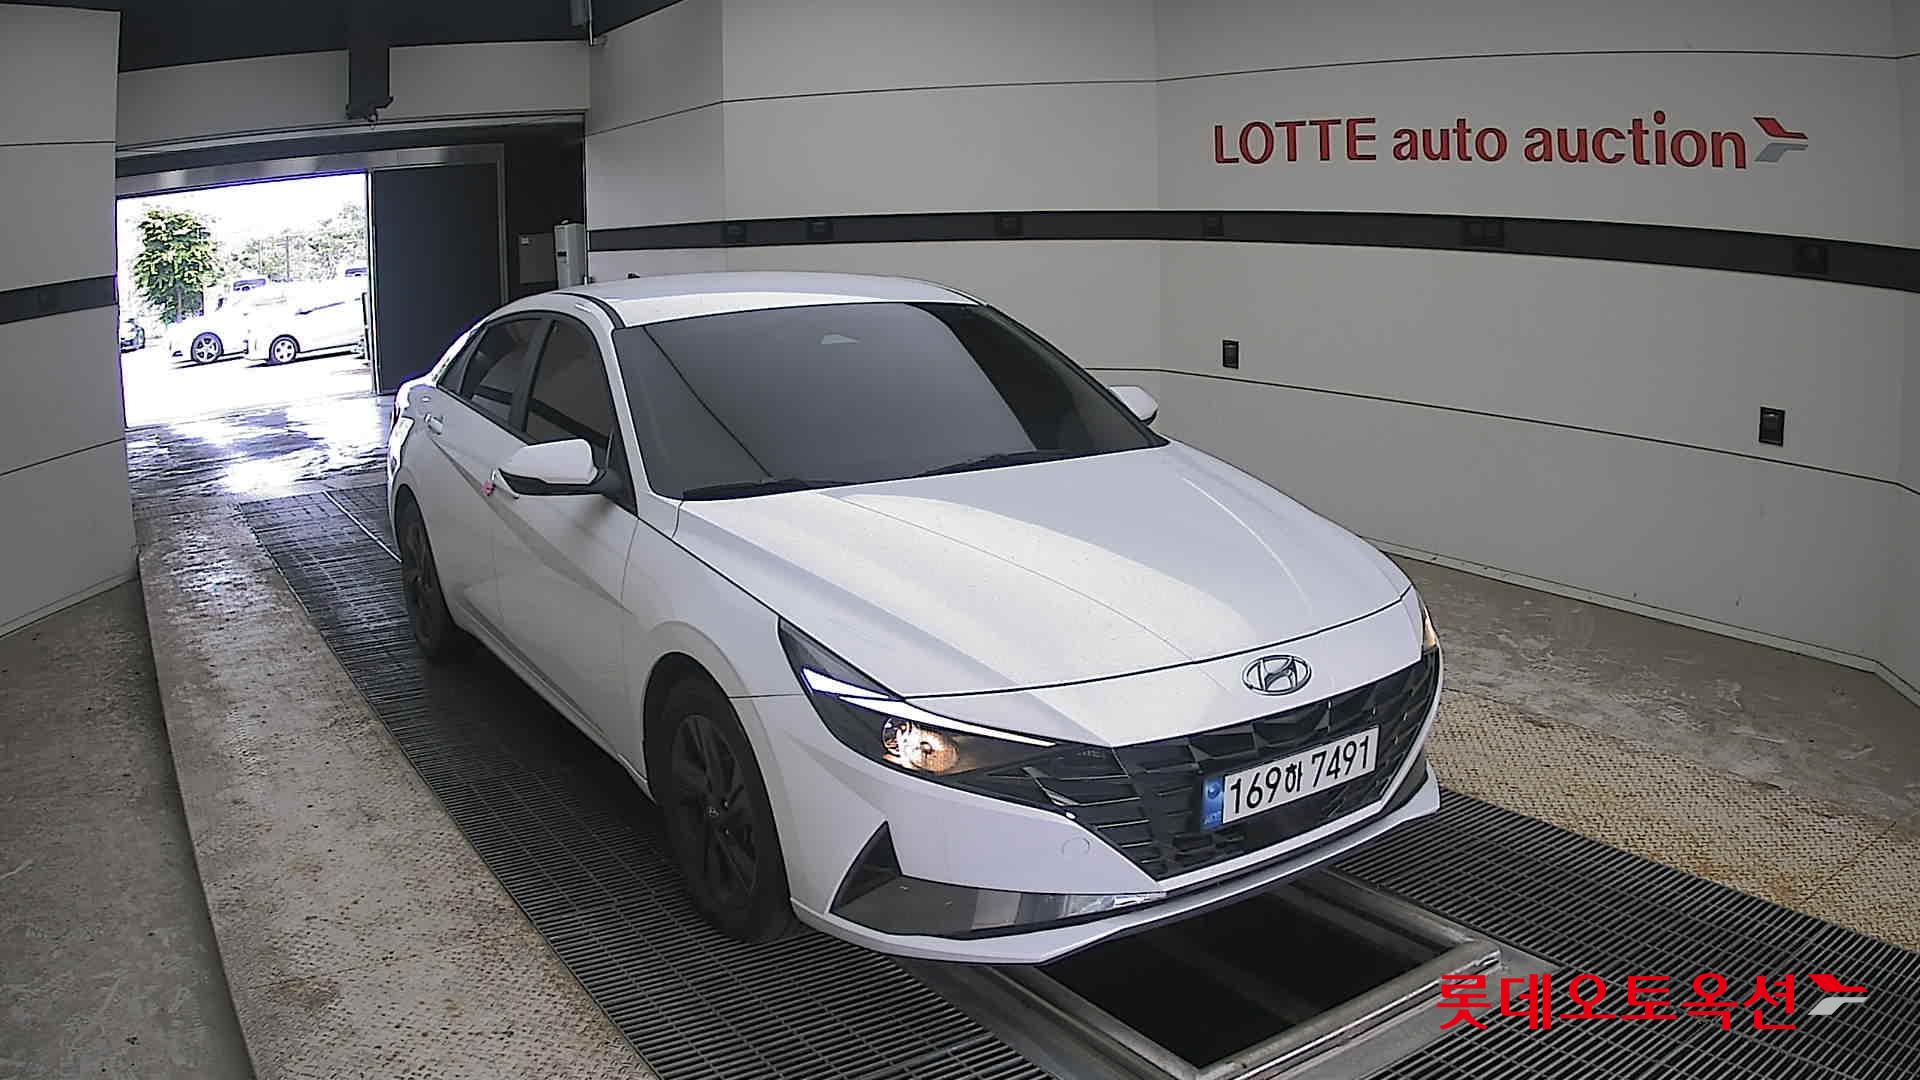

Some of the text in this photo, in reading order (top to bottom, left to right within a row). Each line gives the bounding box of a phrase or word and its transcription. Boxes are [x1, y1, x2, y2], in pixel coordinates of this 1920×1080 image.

[1213, 110, 1747, 169] LOTTE auto auction
[1230, 735, 1370, 814] 169하 7491
